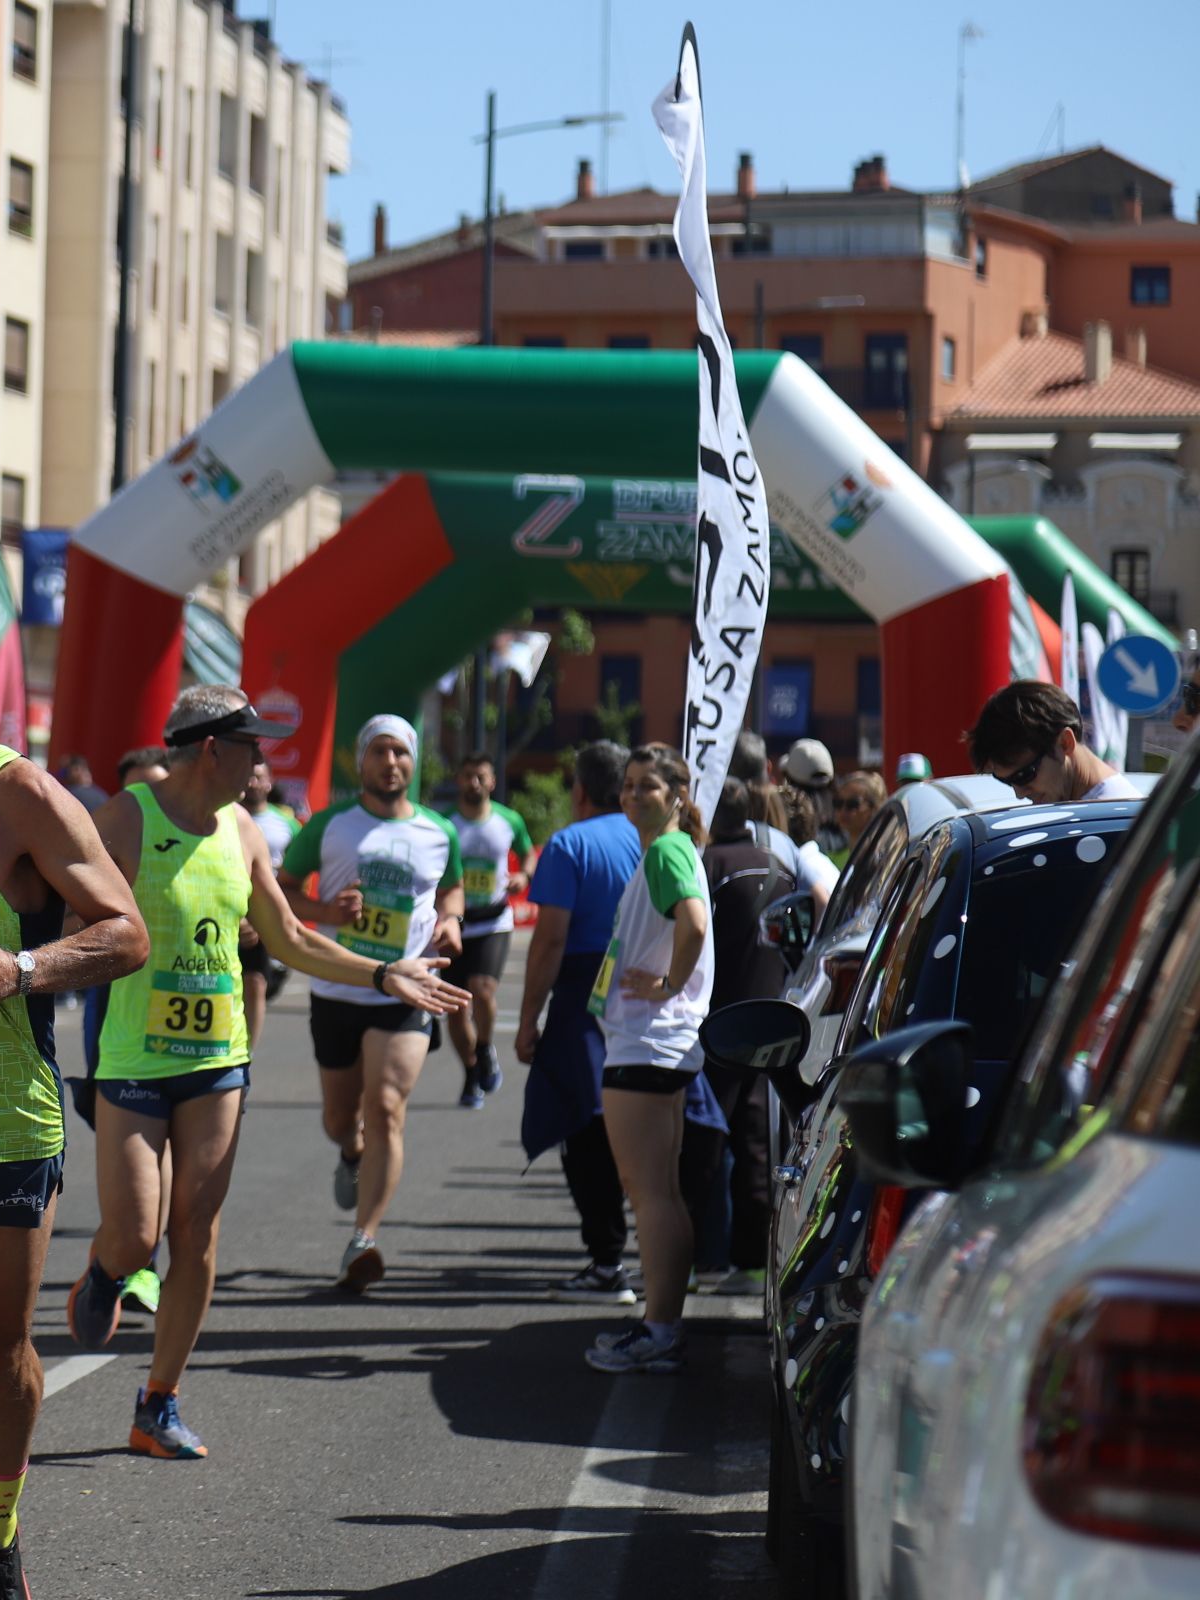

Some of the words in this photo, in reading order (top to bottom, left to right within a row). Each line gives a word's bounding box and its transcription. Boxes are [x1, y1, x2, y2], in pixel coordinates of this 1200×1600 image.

[612, 480, 698, 511] DIPUT
[732, 432, 766, 607] ZAMO
[165, 996, 214, 1033] 39
[170, 1044, 196, 1053] CAJA
